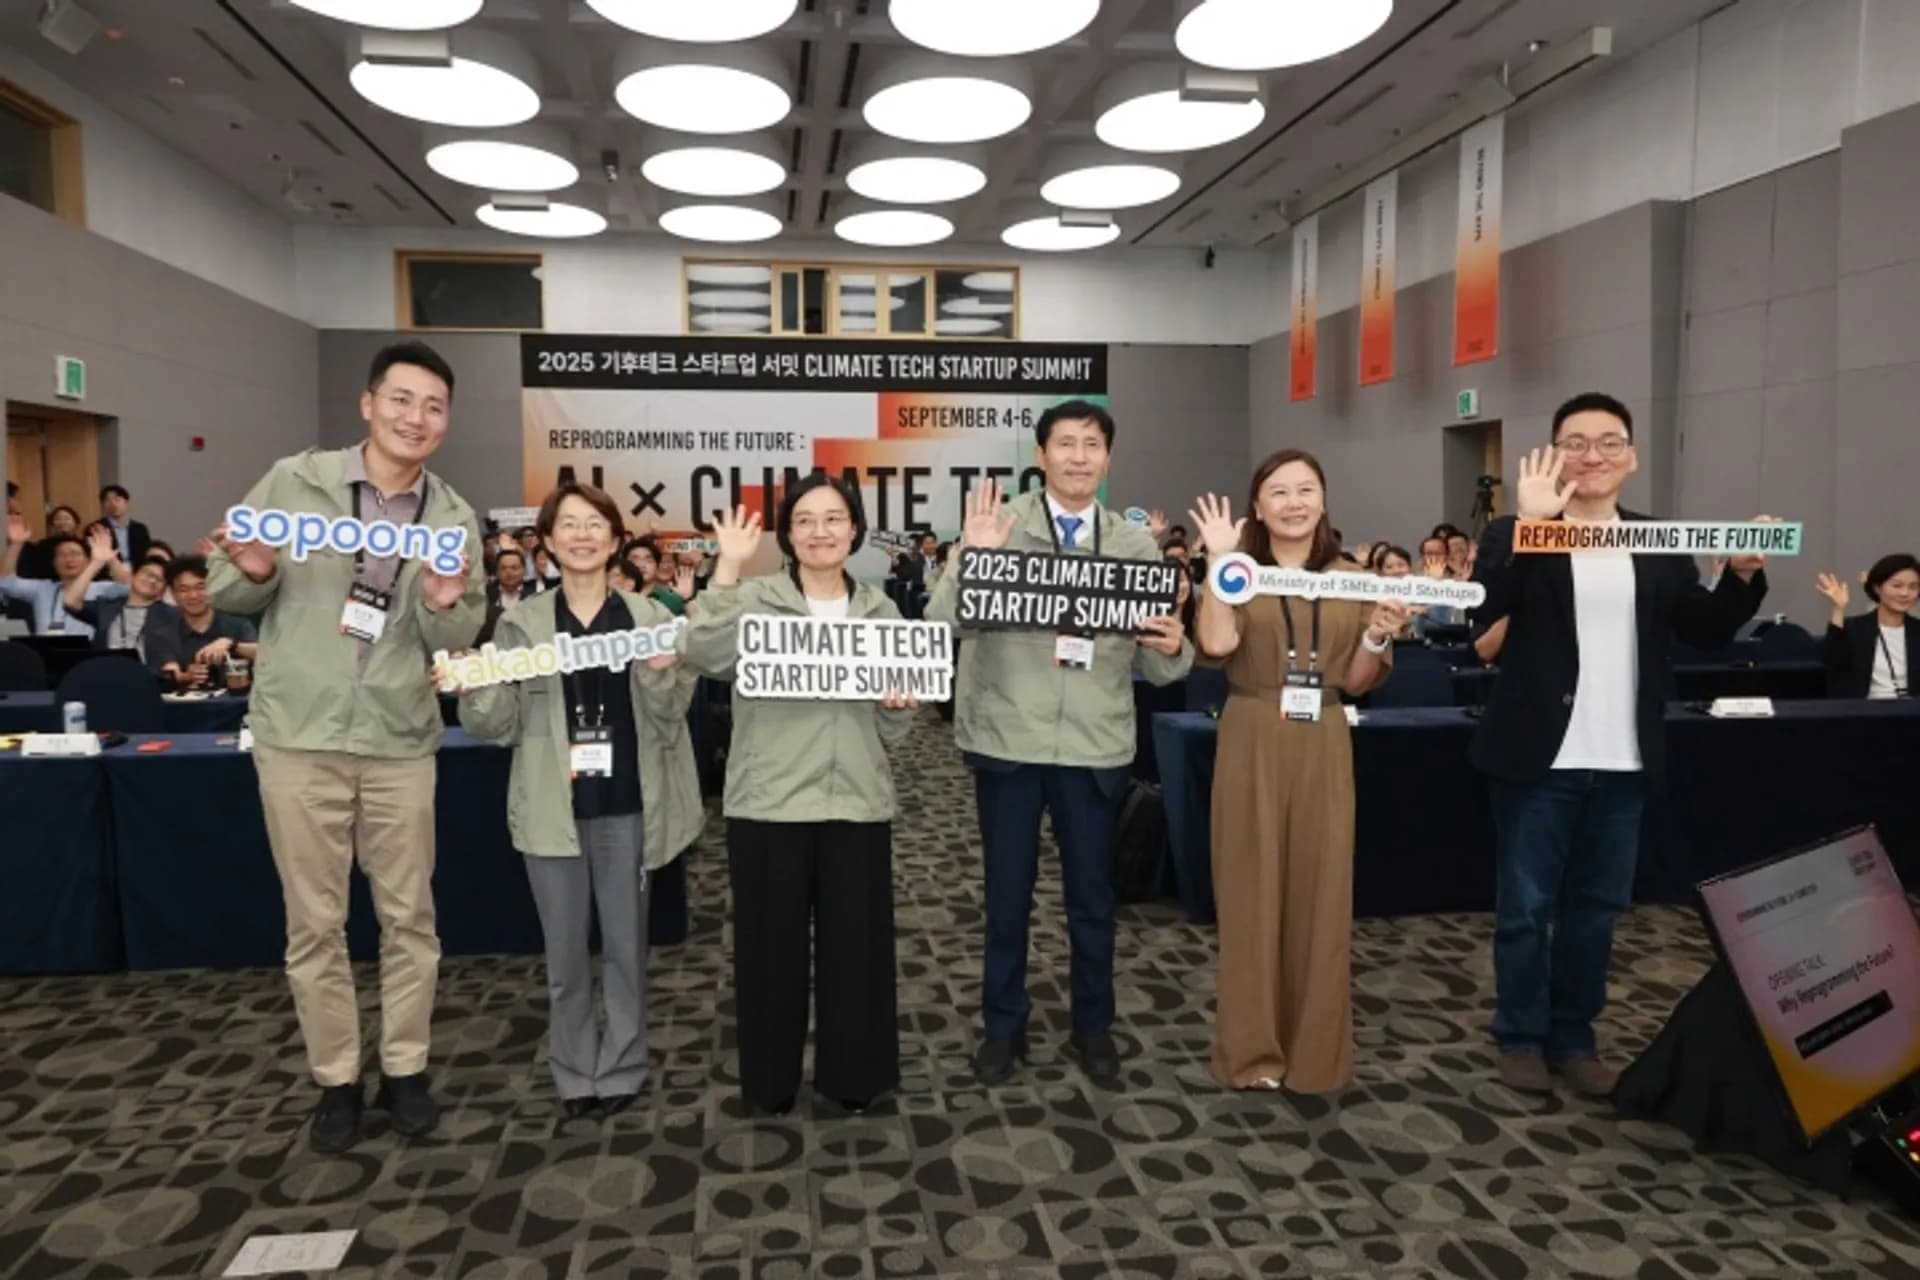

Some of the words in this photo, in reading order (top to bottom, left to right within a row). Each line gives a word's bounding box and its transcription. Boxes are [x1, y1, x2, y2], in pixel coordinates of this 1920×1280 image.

[538, 351, 595, 372] 2025
[601, 351, 677, 375] 기후테크
[682, 353, 756, 376] 스타트업
[762, 353, 799, 377] 서밋
[804, 354, 883, 378] CLIMATE
[888, 355, 935, 378] TECH
[939, 356, 1017, 380] STARTUP
[898, 407, 997, 428] SEPTEMBER
[549, 429, 694, 451] REPROGRAMMING
[699, 431, 729, 450] THE
[735, 432, 795, 451] FUTURE
[229, 508, 463, 573] sopoong
[1519, 525, 1680, 549] REPROGRAMMING
[1685, 527, 1719, 549] THE
[1725, 528, 1796, 550] FUTURE
[963, 552, 1019, 582] 2025
[1026, 557, 1116, 590] CLIMATE
[1123, 564, 1176, 593] TECH
[1259, 575, 1316, 592] Ministry
[1320, 577, 1335, 590] of
[1341, 579, 1377, 594] SMEs
[1382, 582, 1410, 595] and
[1416, 584, 1478, 601] Startups
[961, 589, 1069, 625] STARTUP
[743, 620, 867, 656] CLIMATE
[875, 625, 947, 660] TECH
[743, 662, 849, 692] STARTUP
